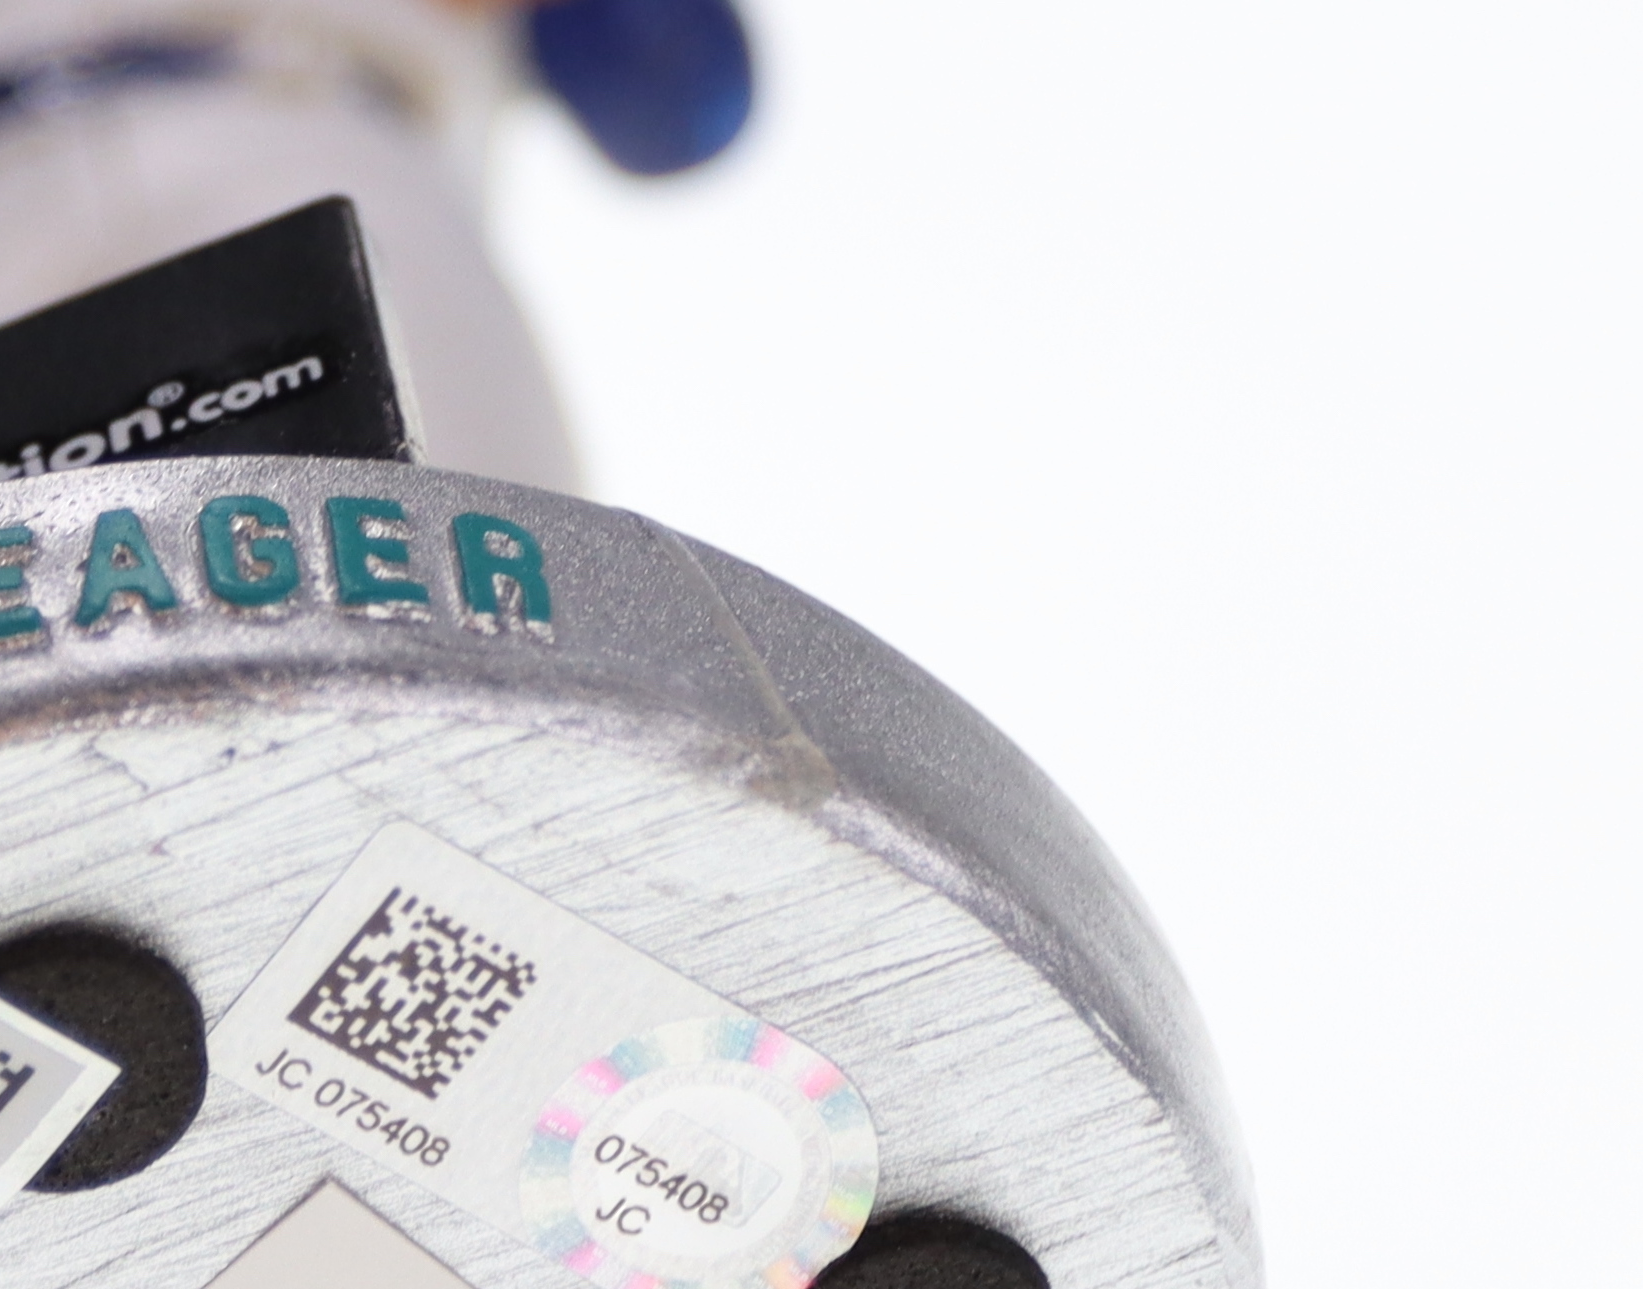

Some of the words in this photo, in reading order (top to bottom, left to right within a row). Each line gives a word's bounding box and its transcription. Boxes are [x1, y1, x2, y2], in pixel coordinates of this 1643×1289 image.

[254, 1047, 313, 1091] JC
[314, 1078, 451, 1167] 075408
[593, 1134, 731, 1225] 075408
[594, 1197, 651, 1235] JC
